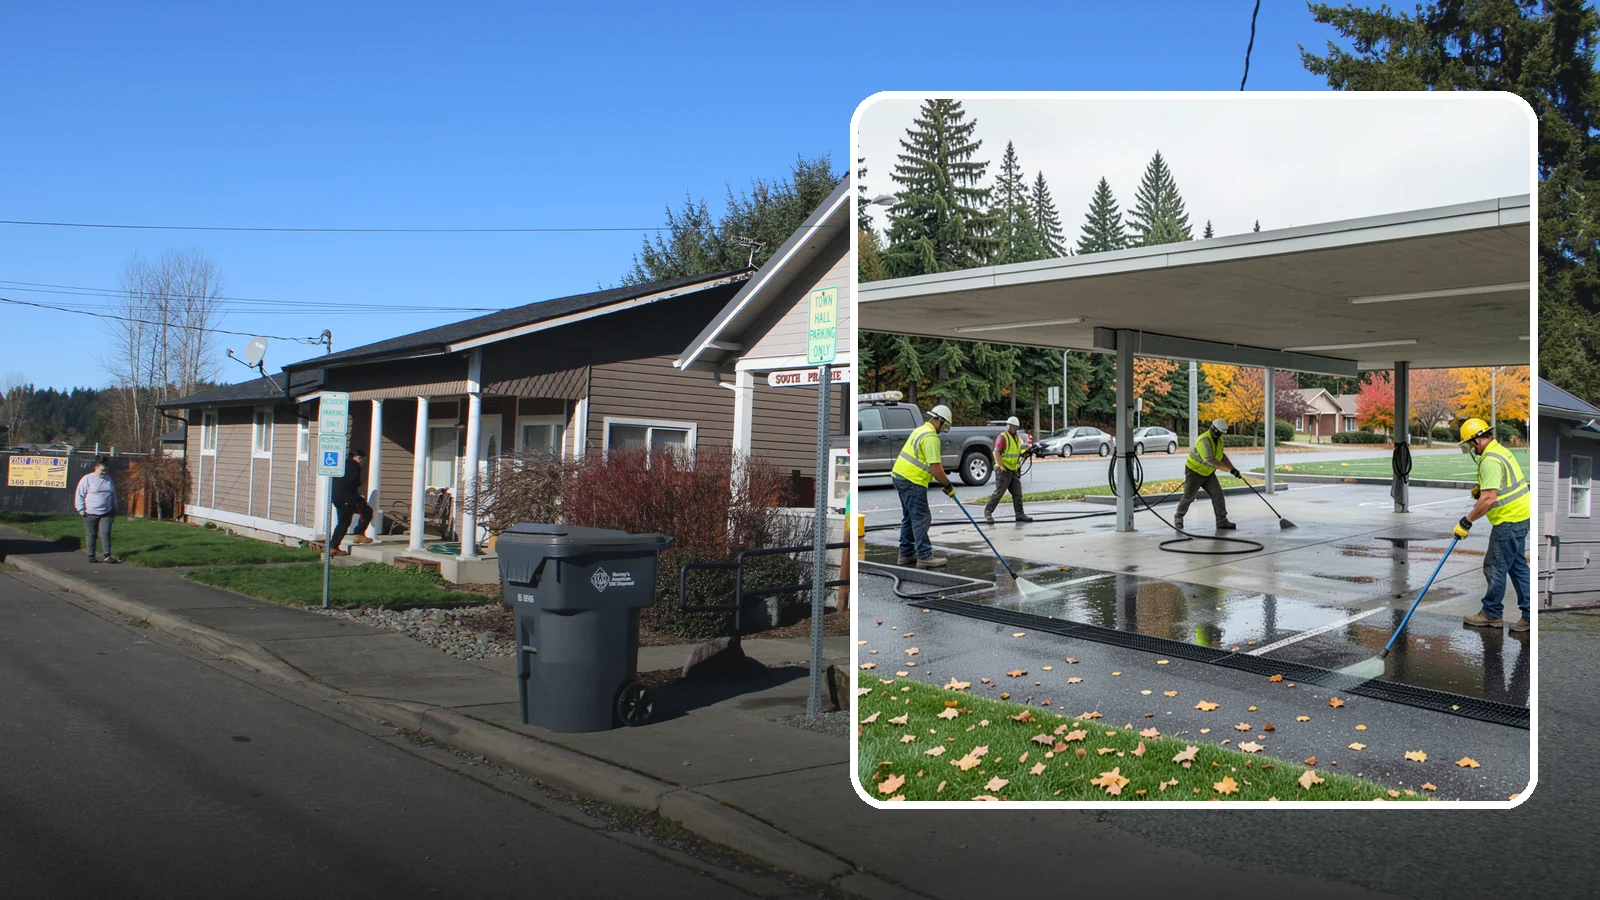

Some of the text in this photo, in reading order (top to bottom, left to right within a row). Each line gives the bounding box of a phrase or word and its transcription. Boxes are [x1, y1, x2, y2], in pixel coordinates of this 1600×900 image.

[815, 295, 833, 308] TOWN
[814, 312, 831, 324] HALL
[810, 326, 836, 340] PARKING
[813, 344, 830, 357] ONLY
[775, 373, 801, 384] SOUTH
[10, 479, 65, 487] 360-897-8625
